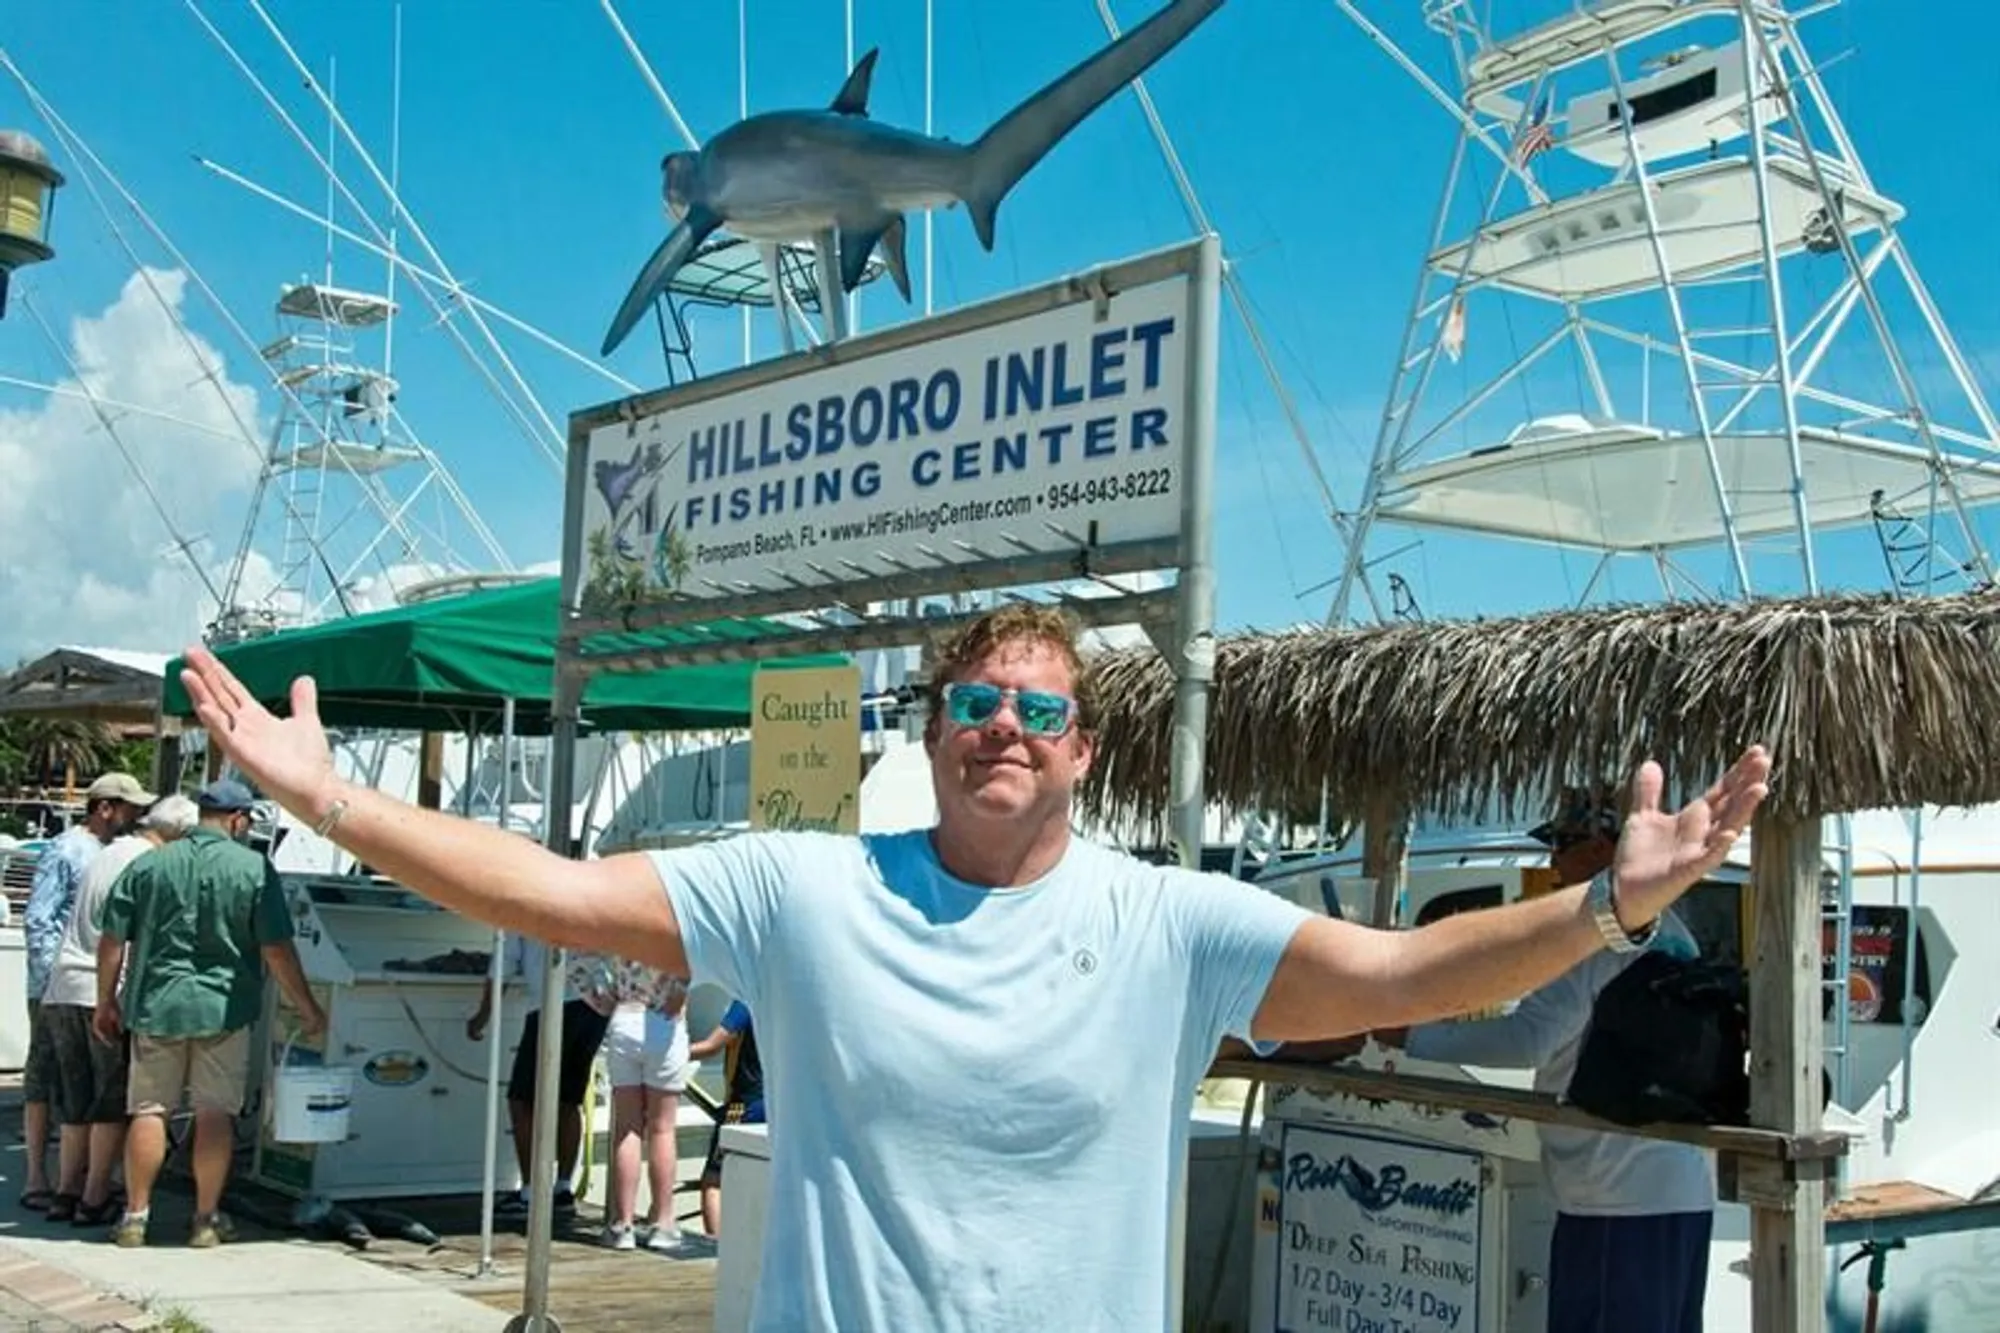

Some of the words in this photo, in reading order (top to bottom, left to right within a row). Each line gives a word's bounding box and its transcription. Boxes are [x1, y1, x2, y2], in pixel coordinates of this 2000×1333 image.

[687, 368, 962, 484] HILLSBORO
[982, 317, 1175, 422] INLET
[685, 461, 882, 530] FISHING
[911, 408, 1170, 486] CENTER
[696, 539, 751, 565] Pompano
[754, 528, 798, 555] Beach,
[800, 524, 818, 547] FL
[1047, 467, 1172, 511] 954-943-8222
[761, 690, 849, 730] Caught
[802, 742, 830, 769] the
[1378, 1164, 1477, 1216] Bandit
[1292, 1261, 1321, 1292] 1/2
[1326, 1270, 1365, 1306] Day
[1380, 1281, 1414, 1312] 3/4
[1420, 1291, 1462, 1330] Day
[1306, 1299, 1341, 1329] Full
